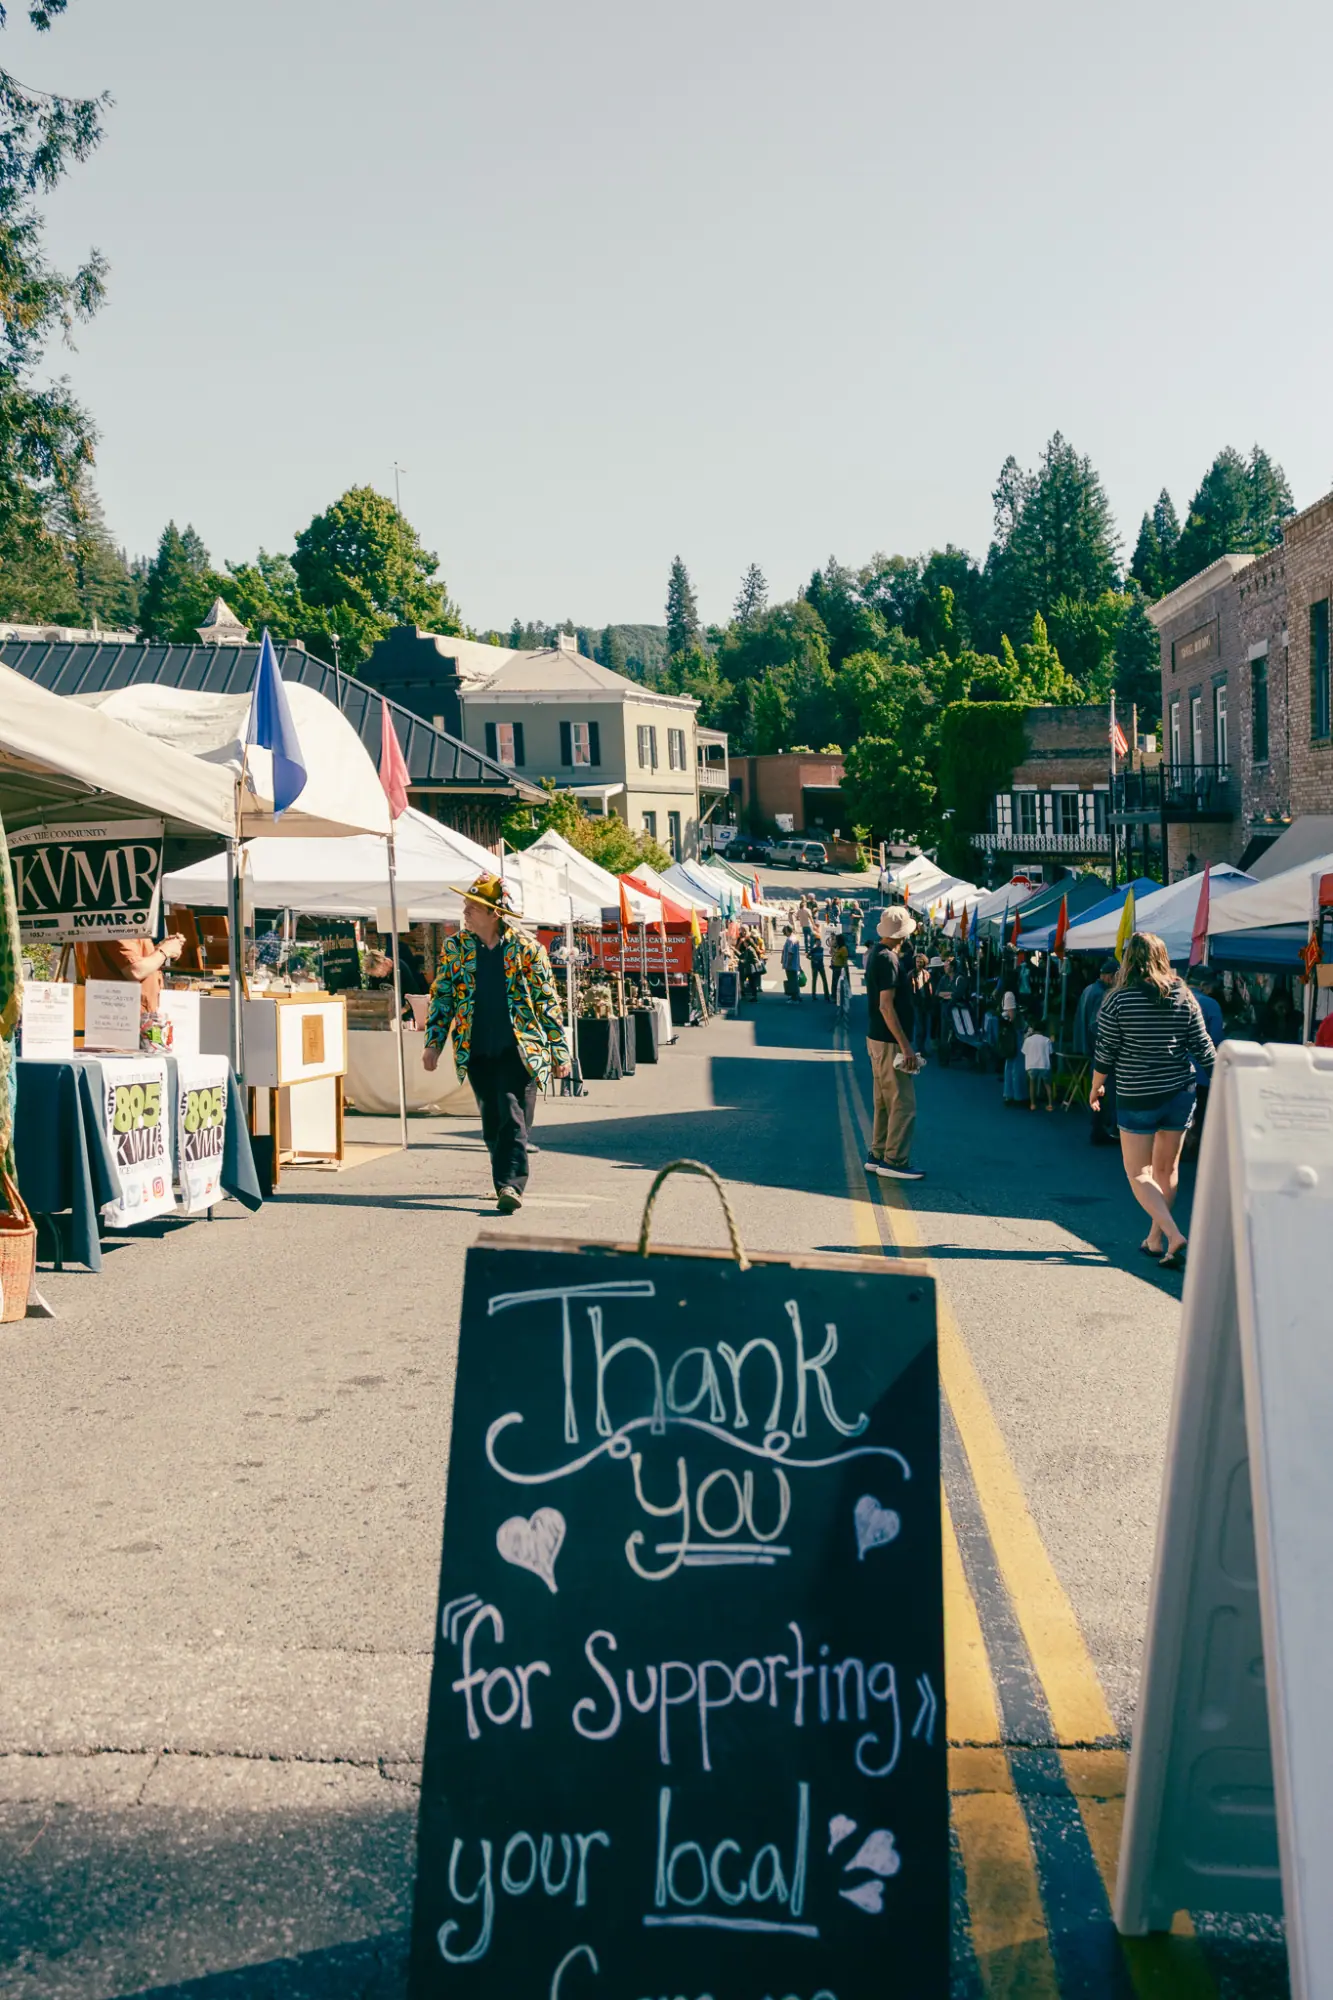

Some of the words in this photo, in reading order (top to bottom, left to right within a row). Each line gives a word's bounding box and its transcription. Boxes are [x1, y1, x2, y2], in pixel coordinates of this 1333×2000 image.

[11, 845, 158, 911] KVMR
[19, 833, 31, 841] OF
[31, 830, 49, 840] THE
[49, 828, 107, 839] COMMUNITY
[73, 912, 150, 928] KVMR.O
[488, 1280, 869, 1443] Thank
[625, 1452, 791, 1581] you
[453, 1604, 551, 1740] for
[572, 1622, 901, 1777] Supporting
[437, 1831, 610, 1963] your
[655, 1782, 809, 1917] local
